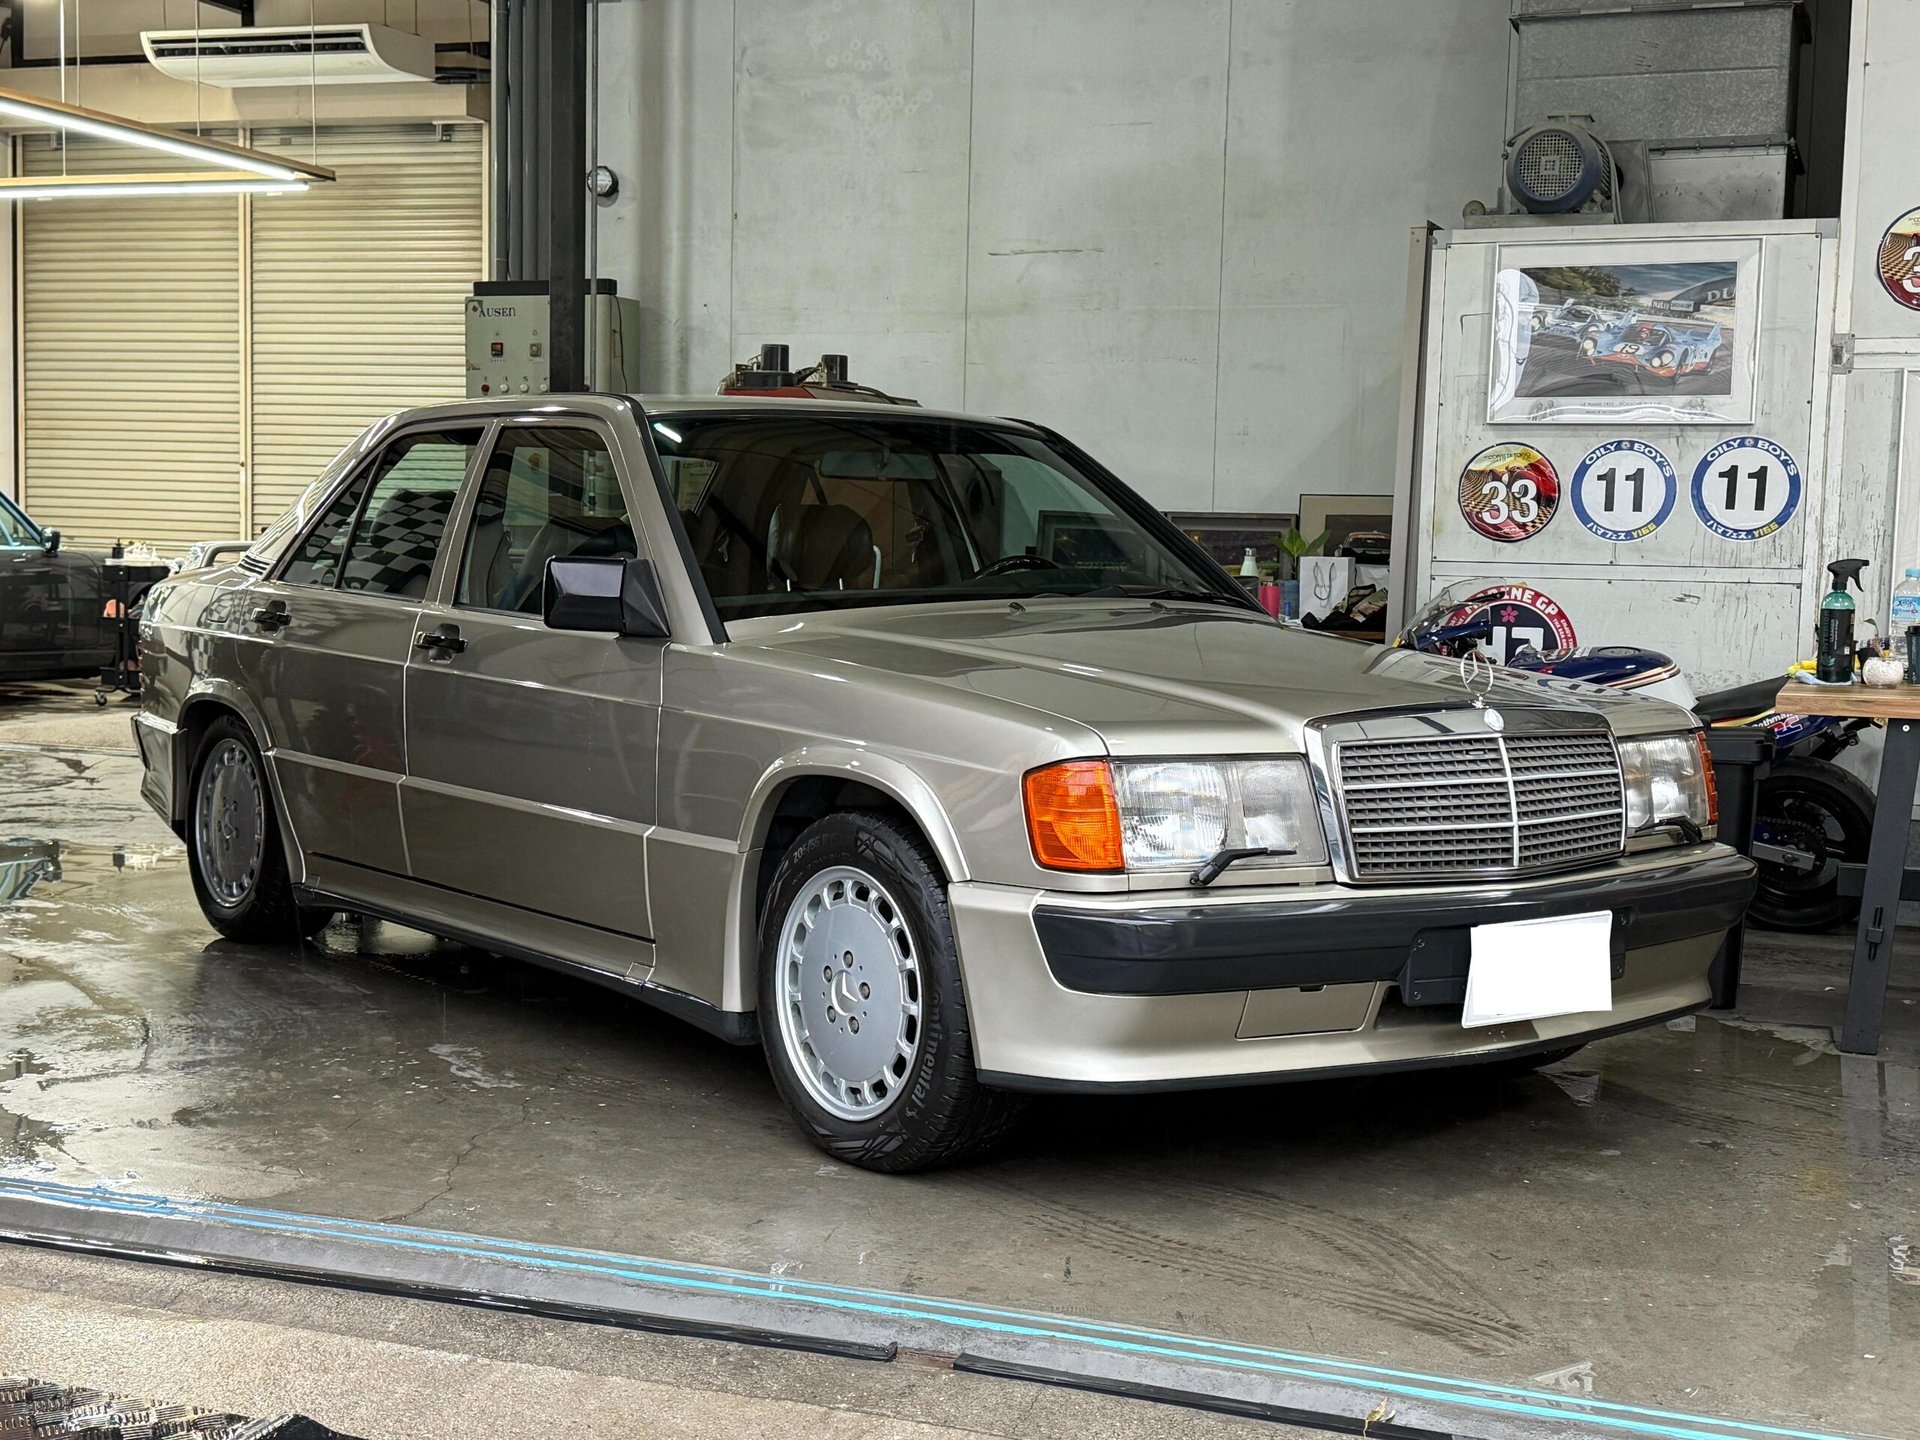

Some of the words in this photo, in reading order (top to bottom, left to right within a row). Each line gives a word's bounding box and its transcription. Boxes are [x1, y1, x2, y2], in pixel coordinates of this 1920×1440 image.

[1619, 343, 1641, 355] 19
[1585, 442, 1619, 465] OILY
[1633, 443, 1673, 477] BOY'S
[1706, 438, 1742, 462] OILY
[1757, 440, 1798, 477] BOY'S
[1481, 479, 1538, 525] 33
[1597, 467, 1645, 512] 11
[1718, 465, 1768, 511] 11
[1586, 522, 1627, 540] ハマフェス
[1706, 520, 1748, 539] ハマフェス
[1535, 596, 1559, 616] GP
